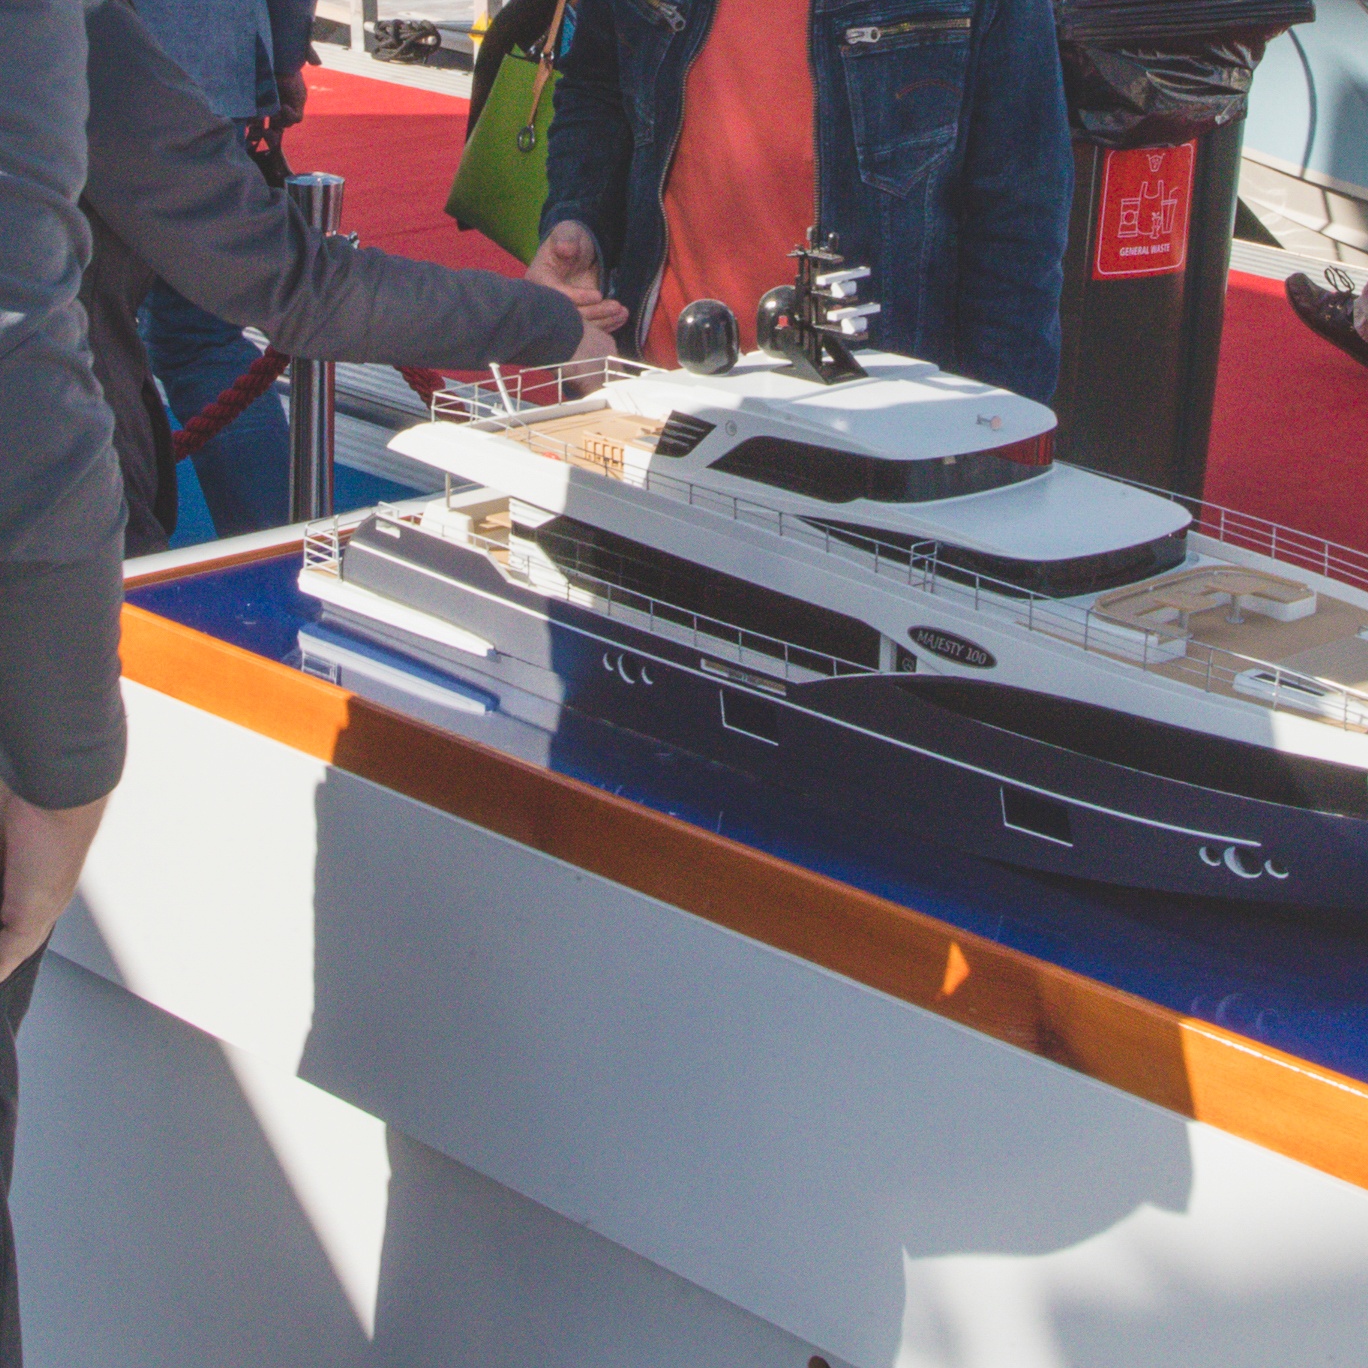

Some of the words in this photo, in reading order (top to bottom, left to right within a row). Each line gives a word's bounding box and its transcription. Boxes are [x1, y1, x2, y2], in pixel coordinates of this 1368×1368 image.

[1119, 245, 1149, 257] GENERAL
[1150, 243, 1171, 254] WASTE
[917, 630, 965, 657] MAJESTY
[965, 647, 988, 665] 100
